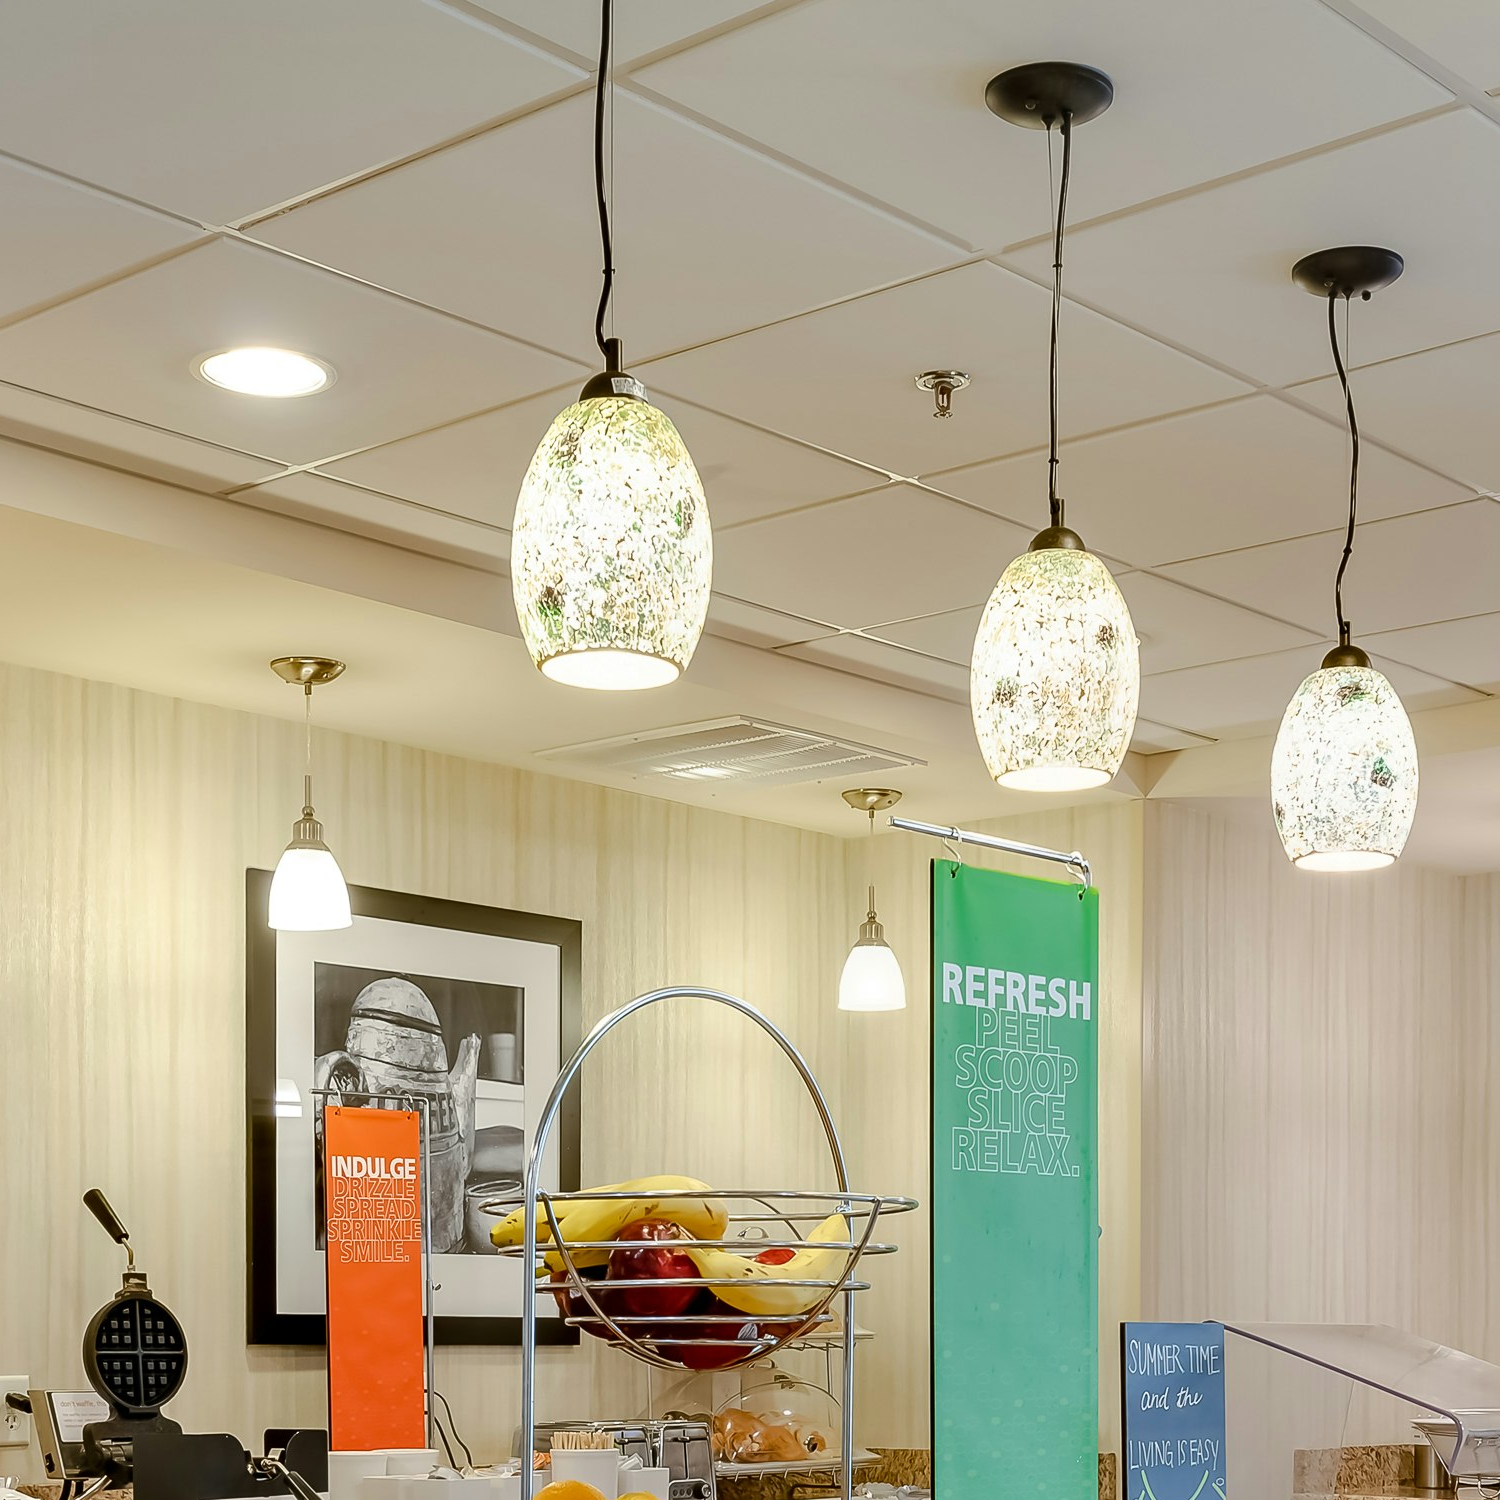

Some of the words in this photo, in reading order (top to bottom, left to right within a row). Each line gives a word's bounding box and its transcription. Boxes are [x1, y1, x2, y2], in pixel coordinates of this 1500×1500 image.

[942, 961, 1091, 1021] REFRESH
[975, 1004, 1061, 1056] PEEL
[955, 1044, 1079, 1097] SCOOP
[967, 1087, 1067, 1136] SLICE
[331, 1155, 417, 1179] INDULGE
[952, 1126, 1080, 1177] RELAX.
[333, 1176, 416, 1200] DRIZZLE
[333, 1197, 416, 1220] SPREAD
[327, 1218, 421, 1242] SPRINKLE
[340, 1240, 410, 1263] SMILE.
[1128, 1339, 1185, 1376] SUMMER
[1185, 1345, 1221, 1375] TIME
[1141, 1386, 1170, 1411] and
[1176, 1386, 1203, 1408] the
[1129, 1440, 1174, 1470] LIVING
[1177, 1439, 1188, 1466] IS
[1189, 1438, 1220, 1471] EASY
